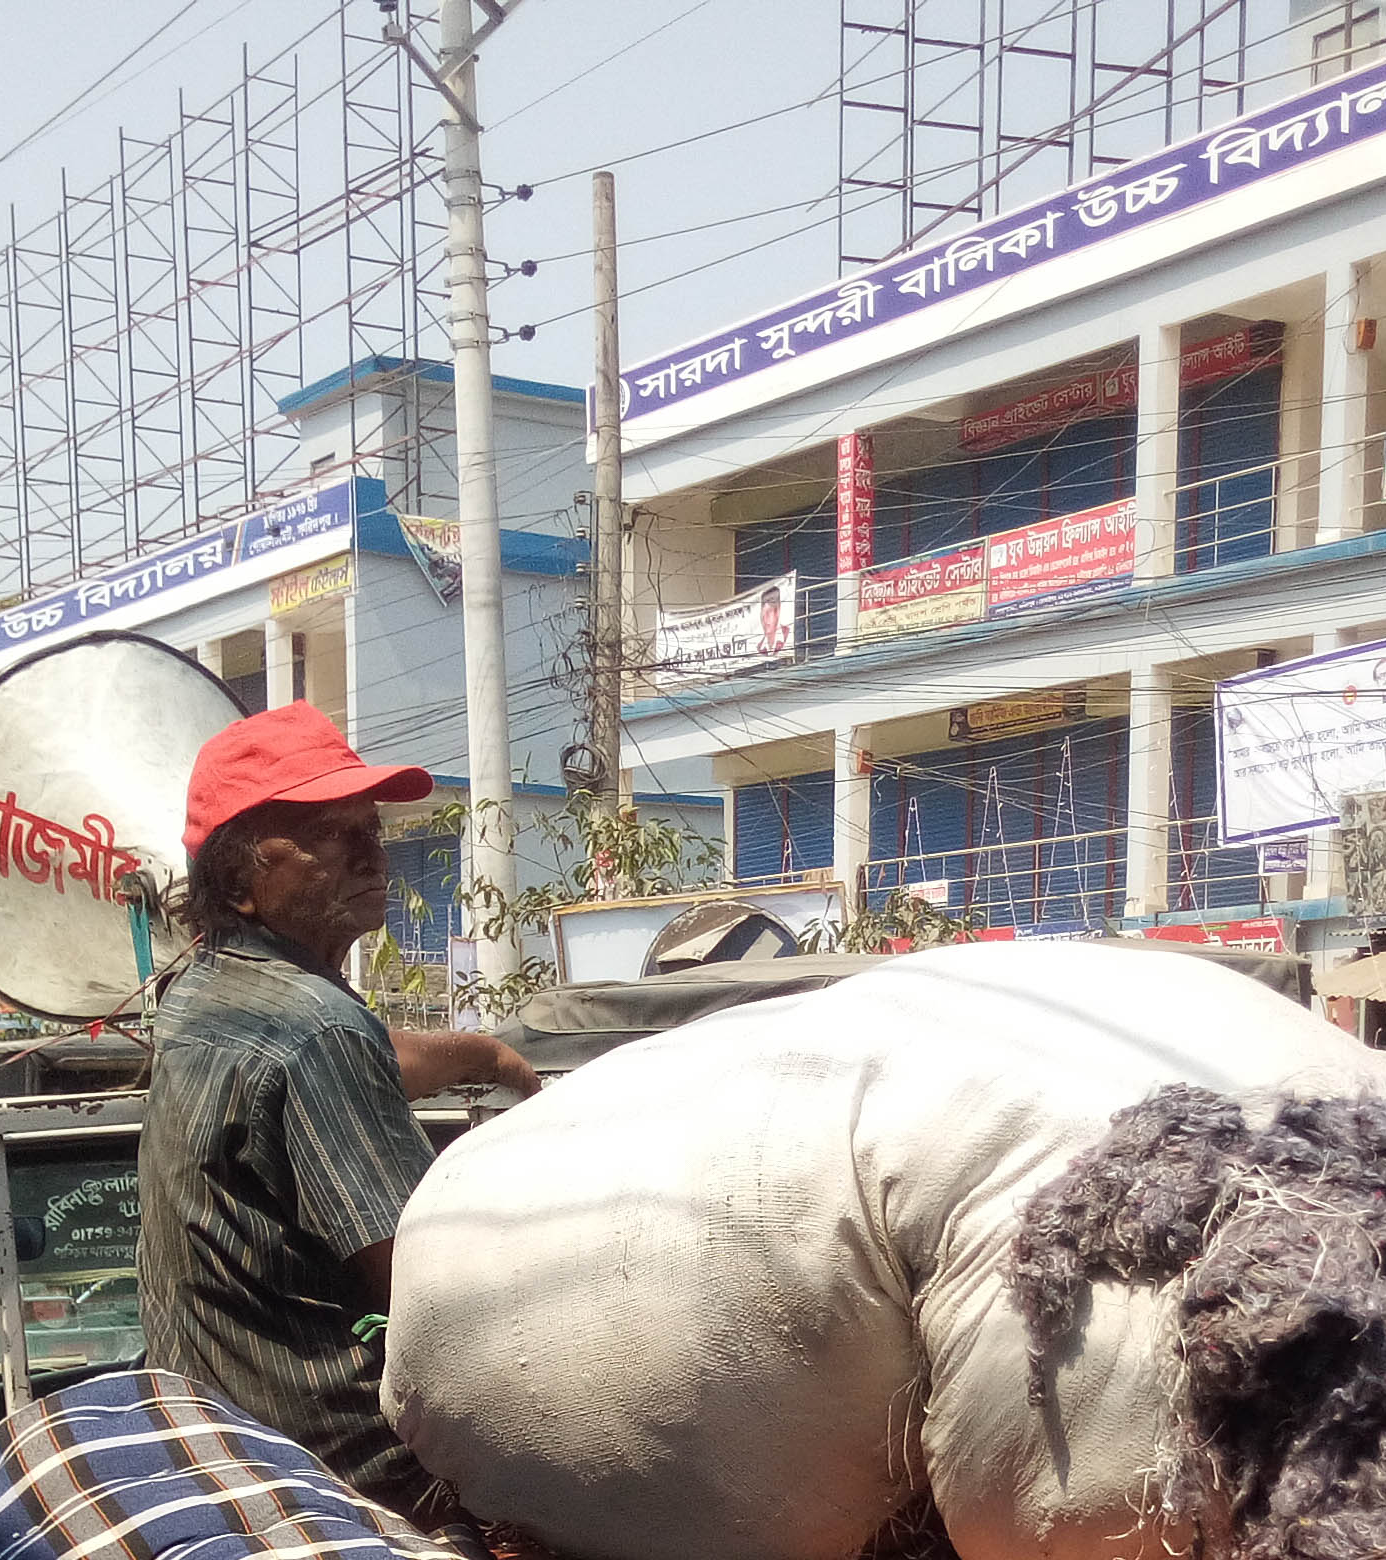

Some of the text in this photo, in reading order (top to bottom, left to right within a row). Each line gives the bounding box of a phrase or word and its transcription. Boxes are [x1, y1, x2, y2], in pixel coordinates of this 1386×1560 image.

[635, 338, 748, 400] সারদা
[757, 281, 884, 360] সুন্দরী
[893, 210, 1066, 299] বালিকা
[1071, 163, 1189, 228] উচ্চ
[1, 601, 66, 639] উচ্চ
[78, 537, 224, 618] বিদ্যালয়
